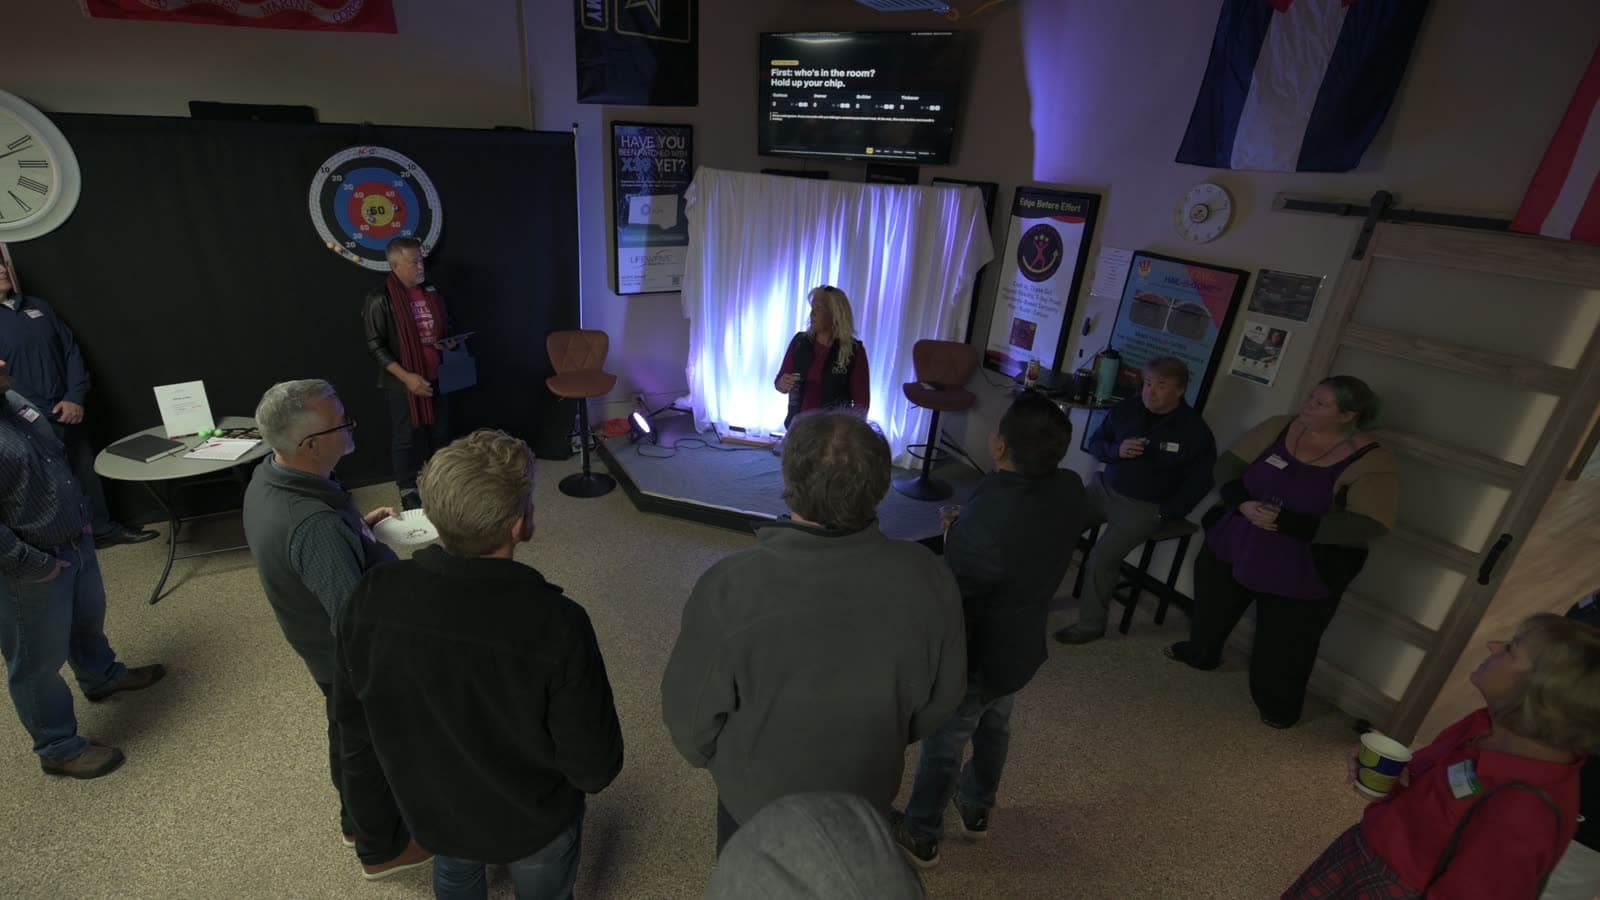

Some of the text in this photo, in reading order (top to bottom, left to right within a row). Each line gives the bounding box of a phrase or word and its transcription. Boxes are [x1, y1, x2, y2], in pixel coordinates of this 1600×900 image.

[771, 68, 876, 78] First: who's in the room?
[771, 78, 846, 89] Hold up your chip.
[621, 135, 685, 149] HAVE YOU
[407, 163, 417, 171] 10
[655, 158, 686, 172] YET?
[320, 166, 331, 174] 10
[400, 170, 411, 178] 20
[332, 174, 343, 182] 20
[344, 183, 355, 191] 30
[1019, 197, 1081, 213] Edge Before Effort
